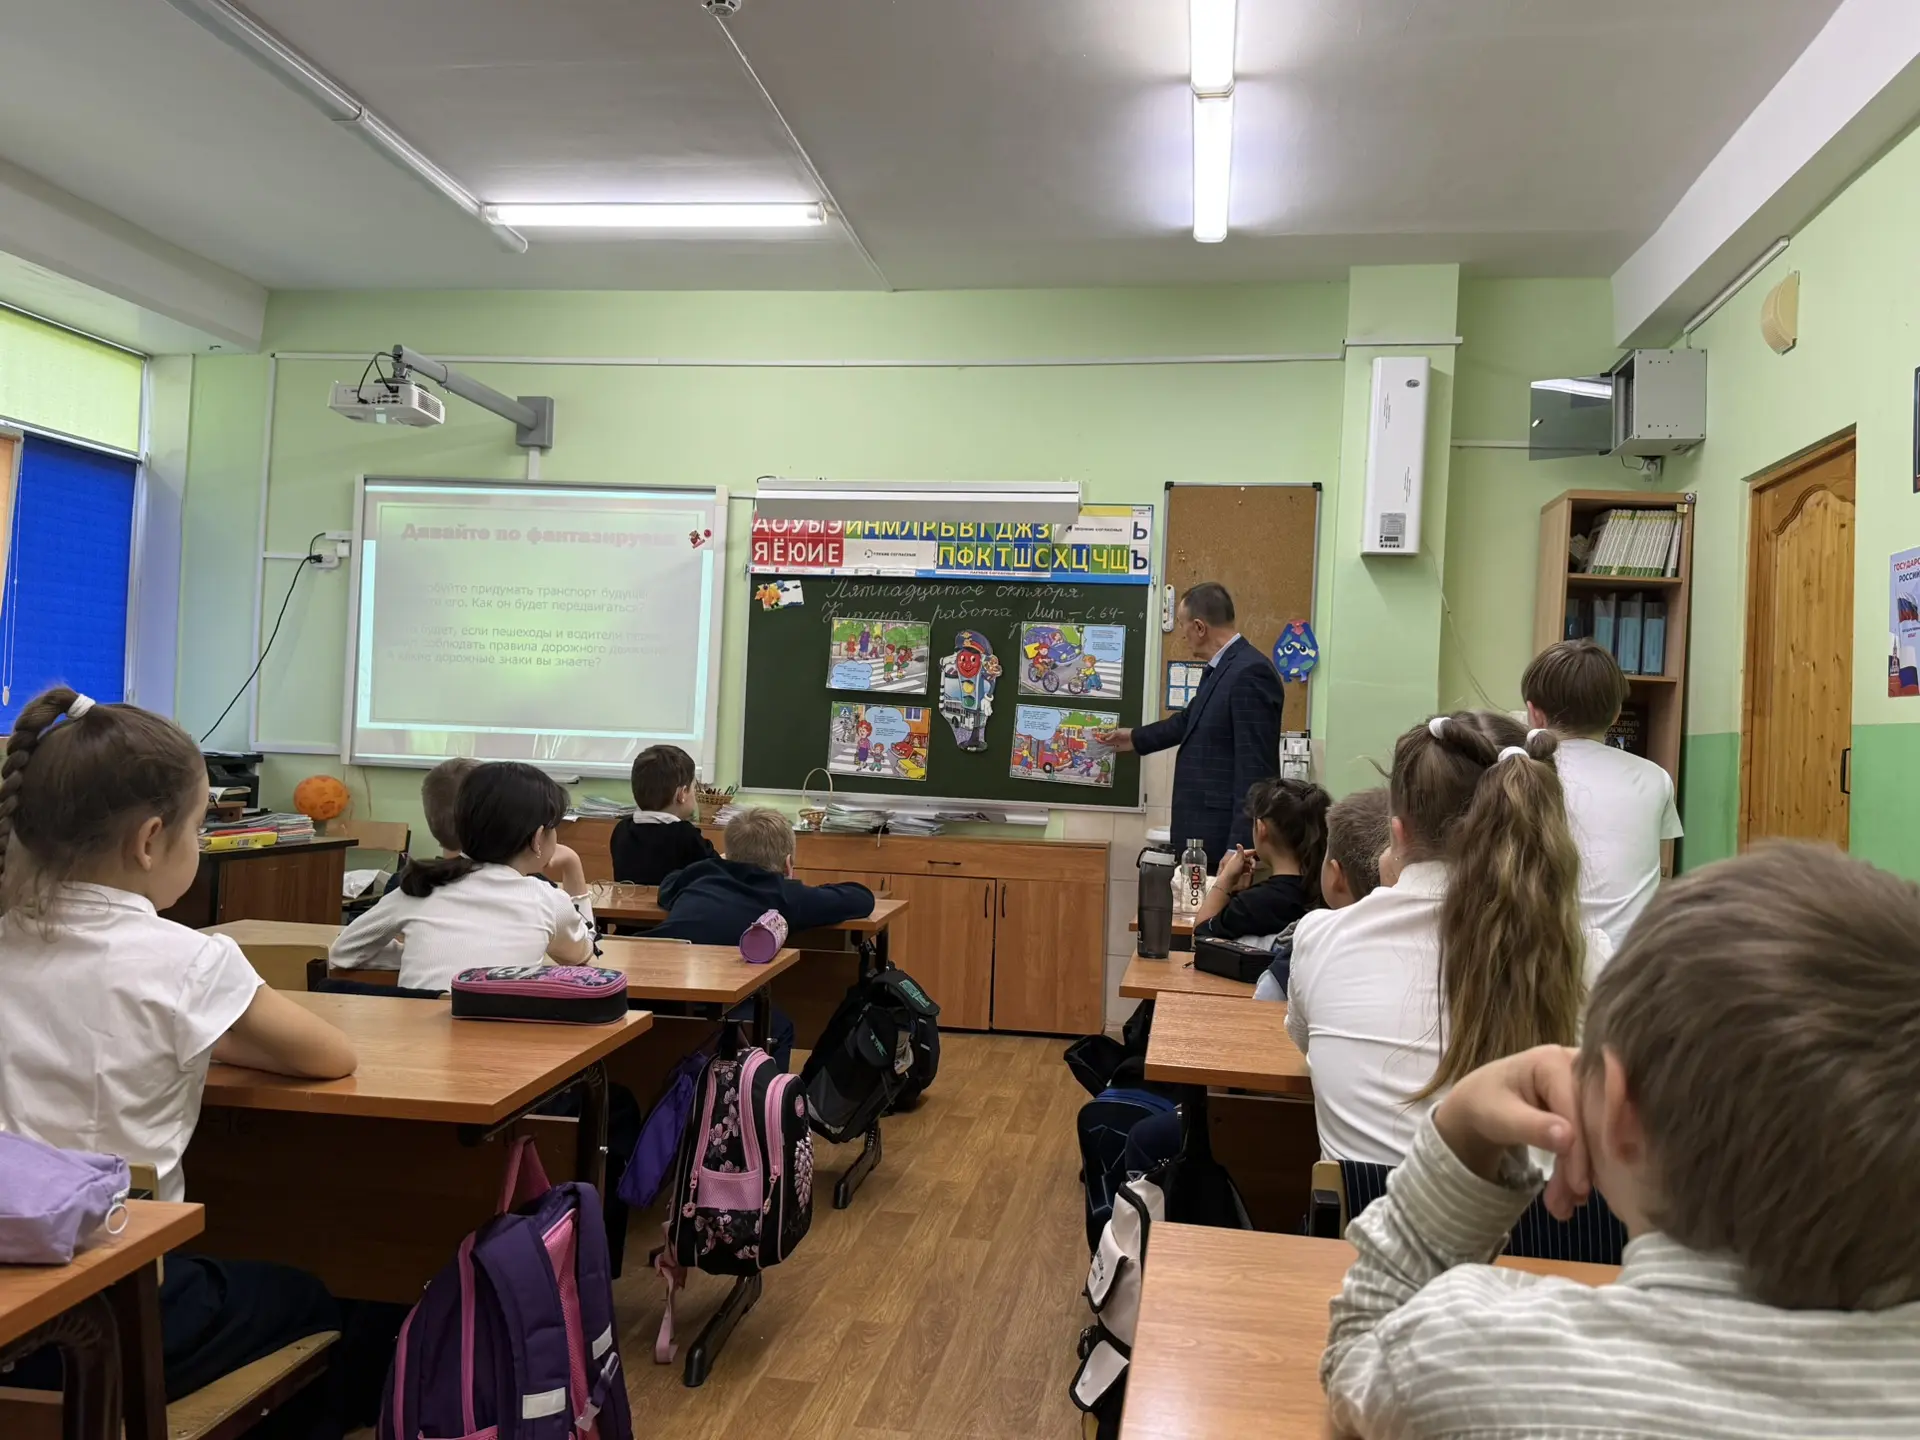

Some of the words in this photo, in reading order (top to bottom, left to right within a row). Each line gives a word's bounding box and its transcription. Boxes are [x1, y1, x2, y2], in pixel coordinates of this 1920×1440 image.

[825, 577, 986, 606] Пятнадцатое
[472, 597, 492, 608] Как
[497, 599, 511, 608] он
[515, 598, 548, 611] будет
[930, 599, 1013, 627] работа
[461, 627, 488, 637] если
[492, 627, 552, 639] пешеходы
[489, 641, 537, 653] правила
[541, 643, 606, 655] дорожного
[499, 655, 532, 665] знаки
[536, 656, 551, 666] вы
[555, 657, 602, 668] знаете?
